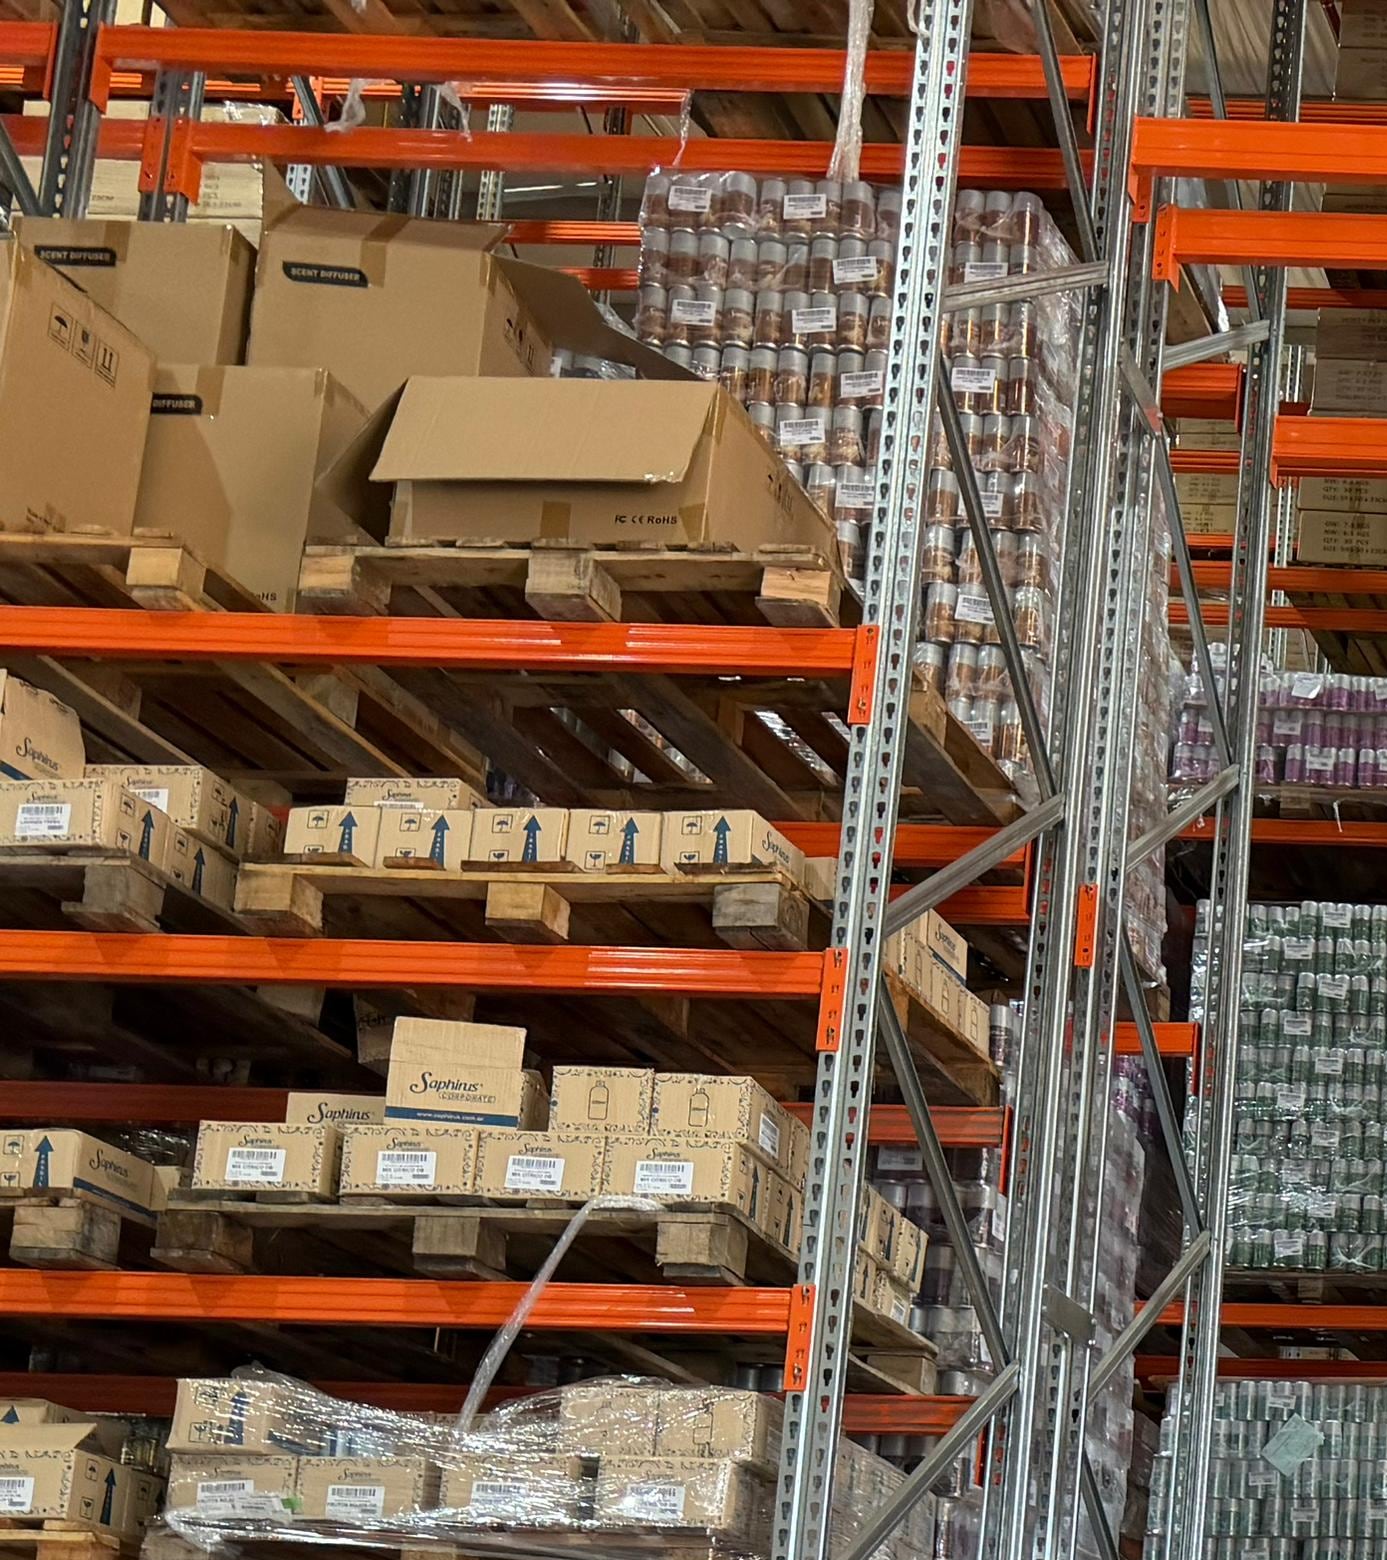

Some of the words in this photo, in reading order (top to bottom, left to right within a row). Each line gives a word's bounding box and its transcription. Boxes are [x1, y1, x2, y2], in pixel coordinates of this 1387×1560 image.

[39, 250, 68, 261] SCENT
[69, 250, 112, 263] DIFFUSER
[290, 266, 318, 279] SCENT
[320, 268, 361, 282] DIFFUSER
[152, 399, 196, 410] DIFFUSER
[647, 514, 678, 525] RoHS
[16, 737, 60, 772] Saphirus
[410, 1071, 484, 1093] Saphirus
[307, 1101, 374, 1124] Saphirus
